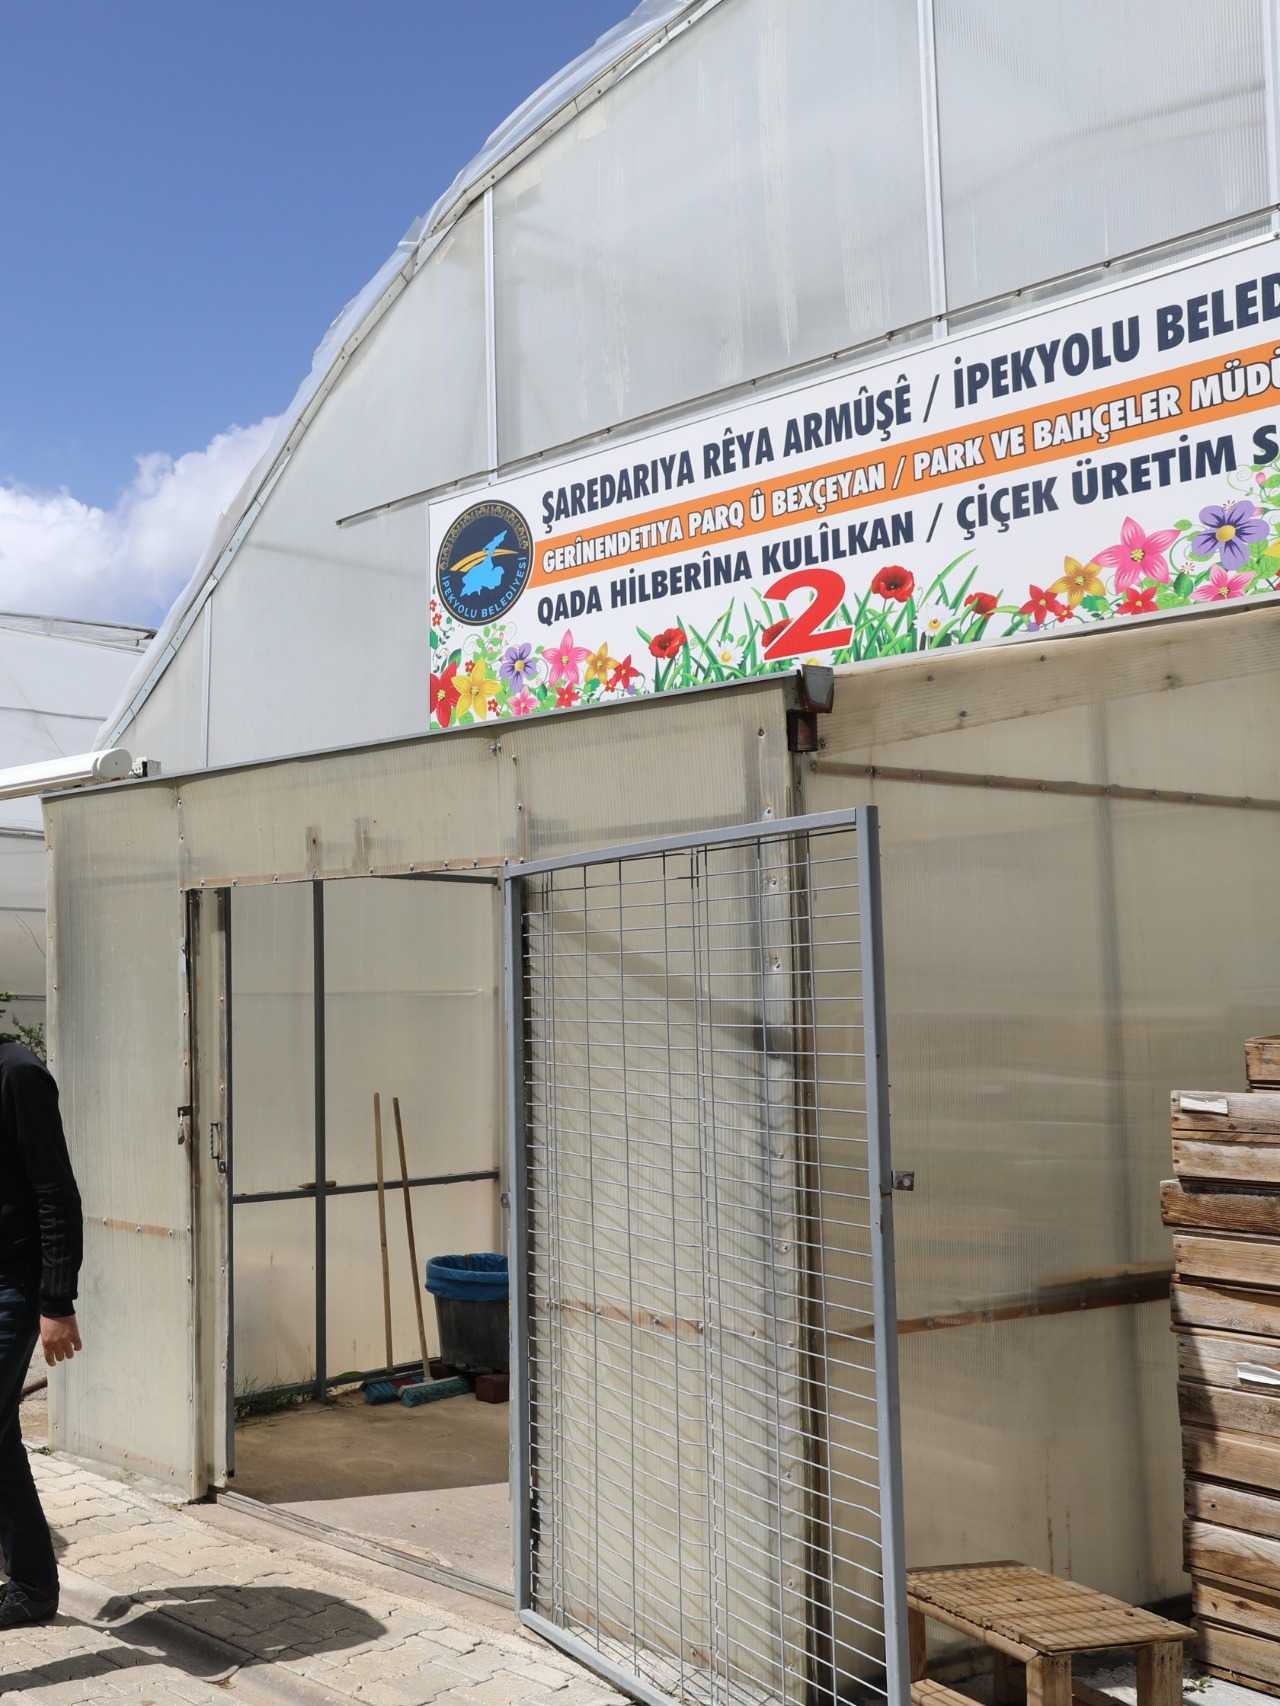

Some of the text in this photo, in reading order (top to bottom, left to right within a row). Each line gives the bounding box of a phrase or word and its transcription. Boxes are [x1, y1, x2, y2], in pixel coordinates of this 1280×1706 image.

[542, 451, 695, 534] ŞAREDARIYA
[703, 426, 775, 480] RÊYA
[783, 373, 912, 458] ARMÛŞÊ
[953, 315, 1140, 409] İPEKYOLU
[1156, 272, 1280, 353] BELED
[543, 525, 682, 573] GERÎNENDETIYA
[688, 506, 744, 536] PARQ
[749, 493, 765, 522] Û
[771, 462, 886, 517] BEXÇEYAN
[914, 437, 985, 481] PARK
[991, 426, 1025, 460] VE
[1033, 385, 1181, 451] BAHÇELER
[537, 585, 603, 627] QADA
[610, 551, 753, 609] HİLBERÎNA
[761, 510, 914, 576] KULÎLKAN
[956, 476, 1059, 541] ÇİÇEK
[1071, 434, 1237, 505] ÜRETİM
[762, 567, 855, 662] 2
